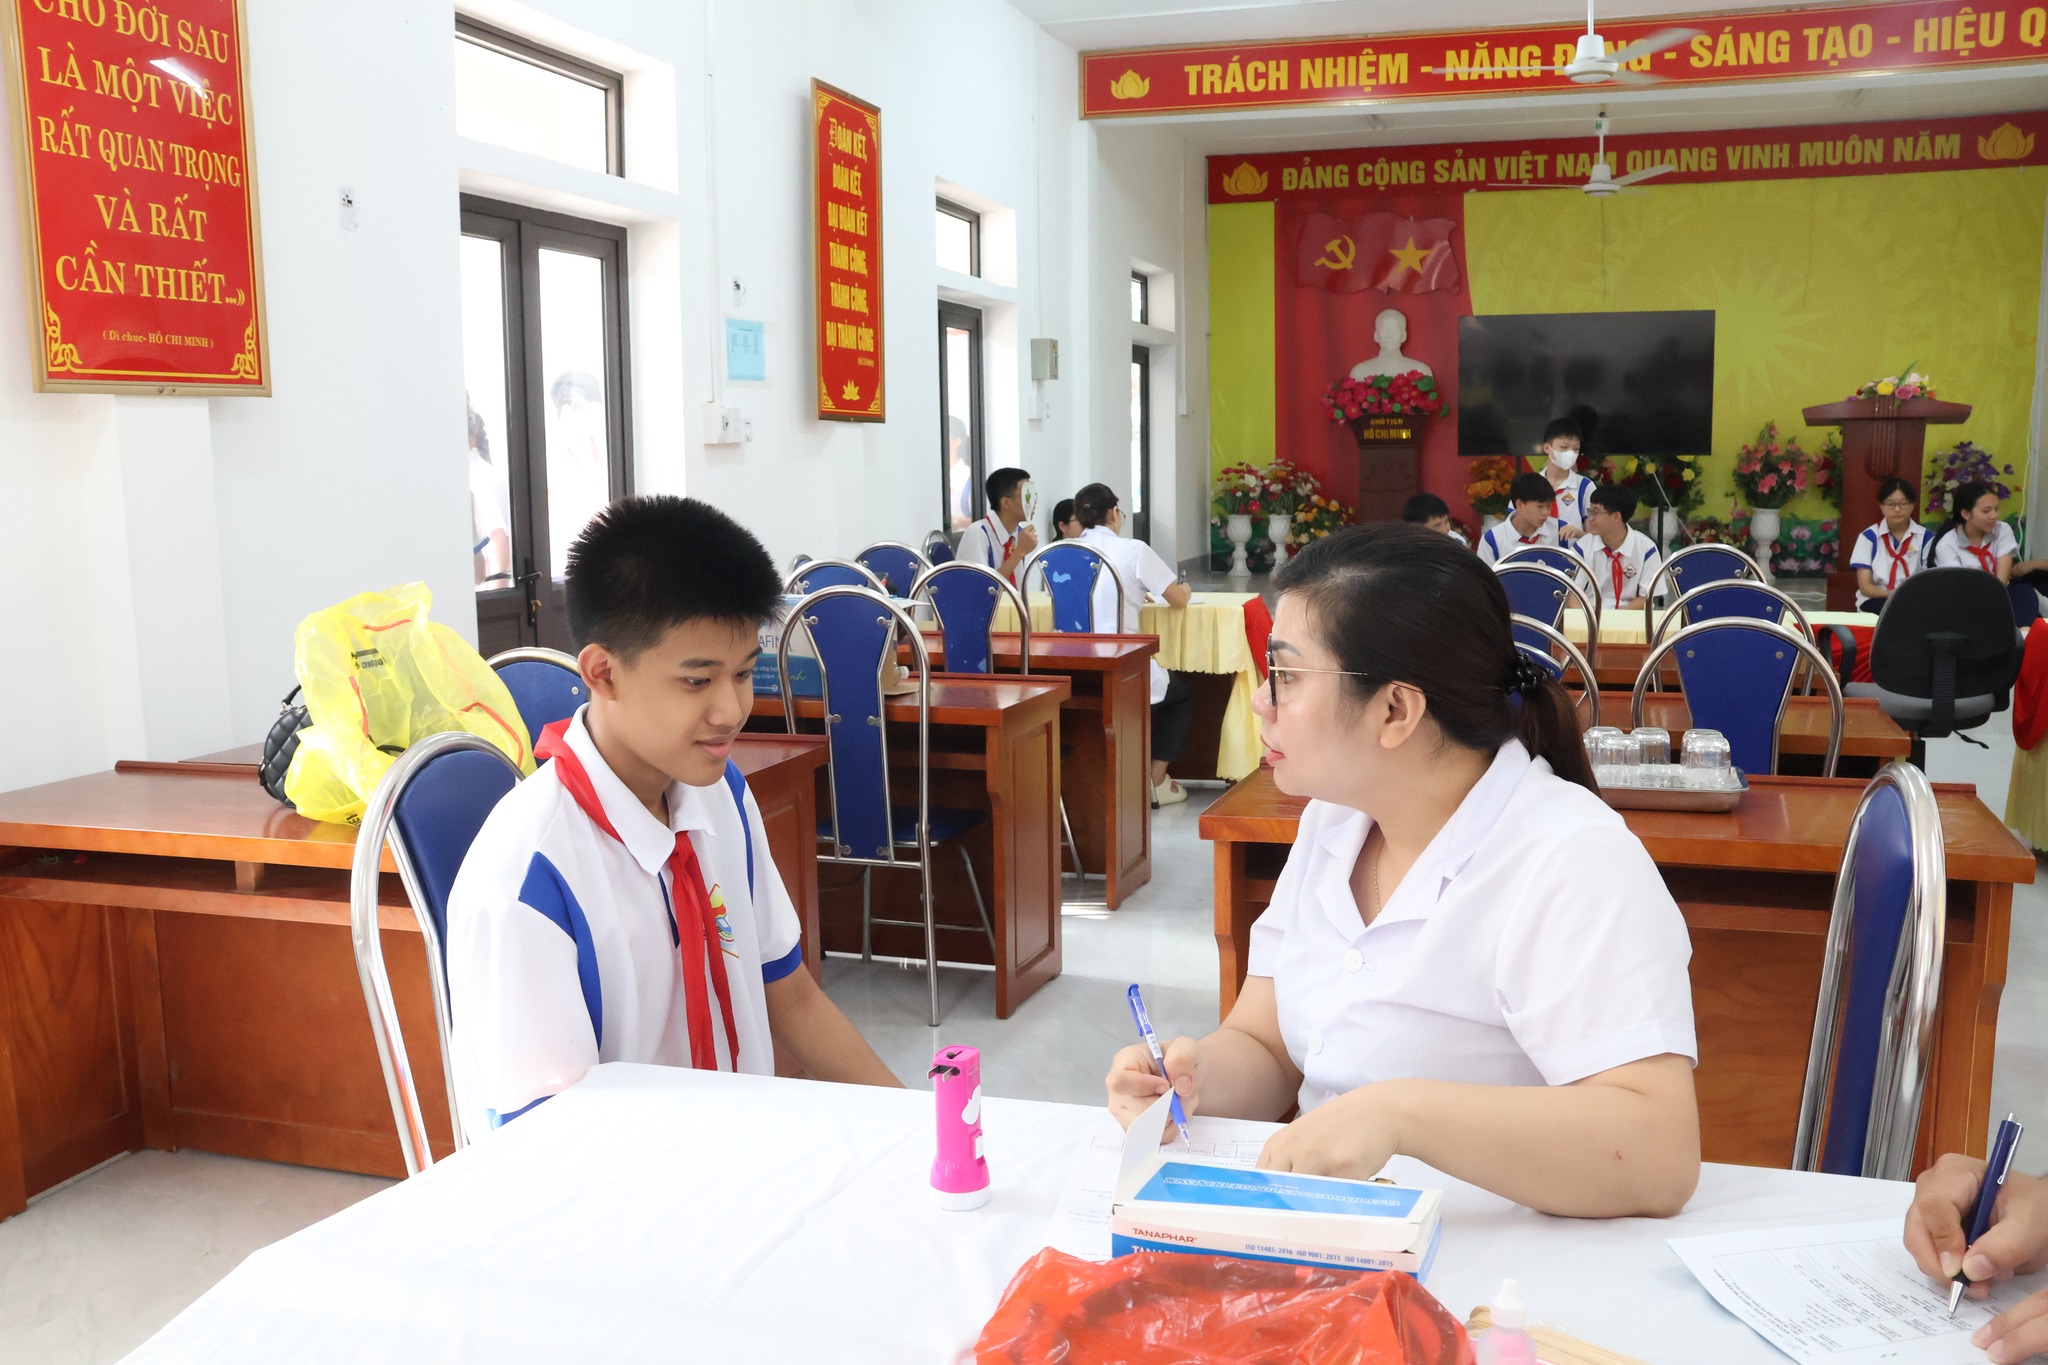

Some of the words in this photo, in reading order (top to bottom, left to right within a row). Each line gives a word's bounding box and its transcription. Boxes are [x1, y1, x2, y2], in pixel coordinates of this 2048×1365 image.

[178, 19, 229, 63] SAU
[1184, 56, 1289, 96] TRÁCH
[1299, 48, 1409, 93] NHIỆM
[1445, 41, 1542, 81] NĂNG
[1553, 38, 1651, 76] ĐNG
[1689, 25, 1790, 71] SÁNG
[1803, 23, 1873, 67] TẠO
[1913, 6, 2006, 57] HIỆU
[38, 41, 87, 91] LÀ
[92, 57, 162, 113] MỘT
[168, 78, 233, 130] VIỆC
[37, 105, 91, 159] RẤT
[98, 129, 164, 172] QUAN
[169, 142, 241, 190] TRỌNG
[1282, 157, 1349, 191] ĐẢNG
[1357, 153, 1426, 191] CỘNG
[1433, 148, 1486, 183] SẢN
[1493, 150, 1548, 181] VIỆT
[1626, 146, 1717, 174] QUANG
[1725, 142, 1790, 170] VINH
[1800, 134, 1884, 167] MUÔN
[1893, 130, 1961, 163] NĂM
[94, 187, 141, 234] VÀ
[148, 193, 207, 242] RẤT
[55, 240, 126, 296] CẦN
[184, 335, 209, 347] MINH
